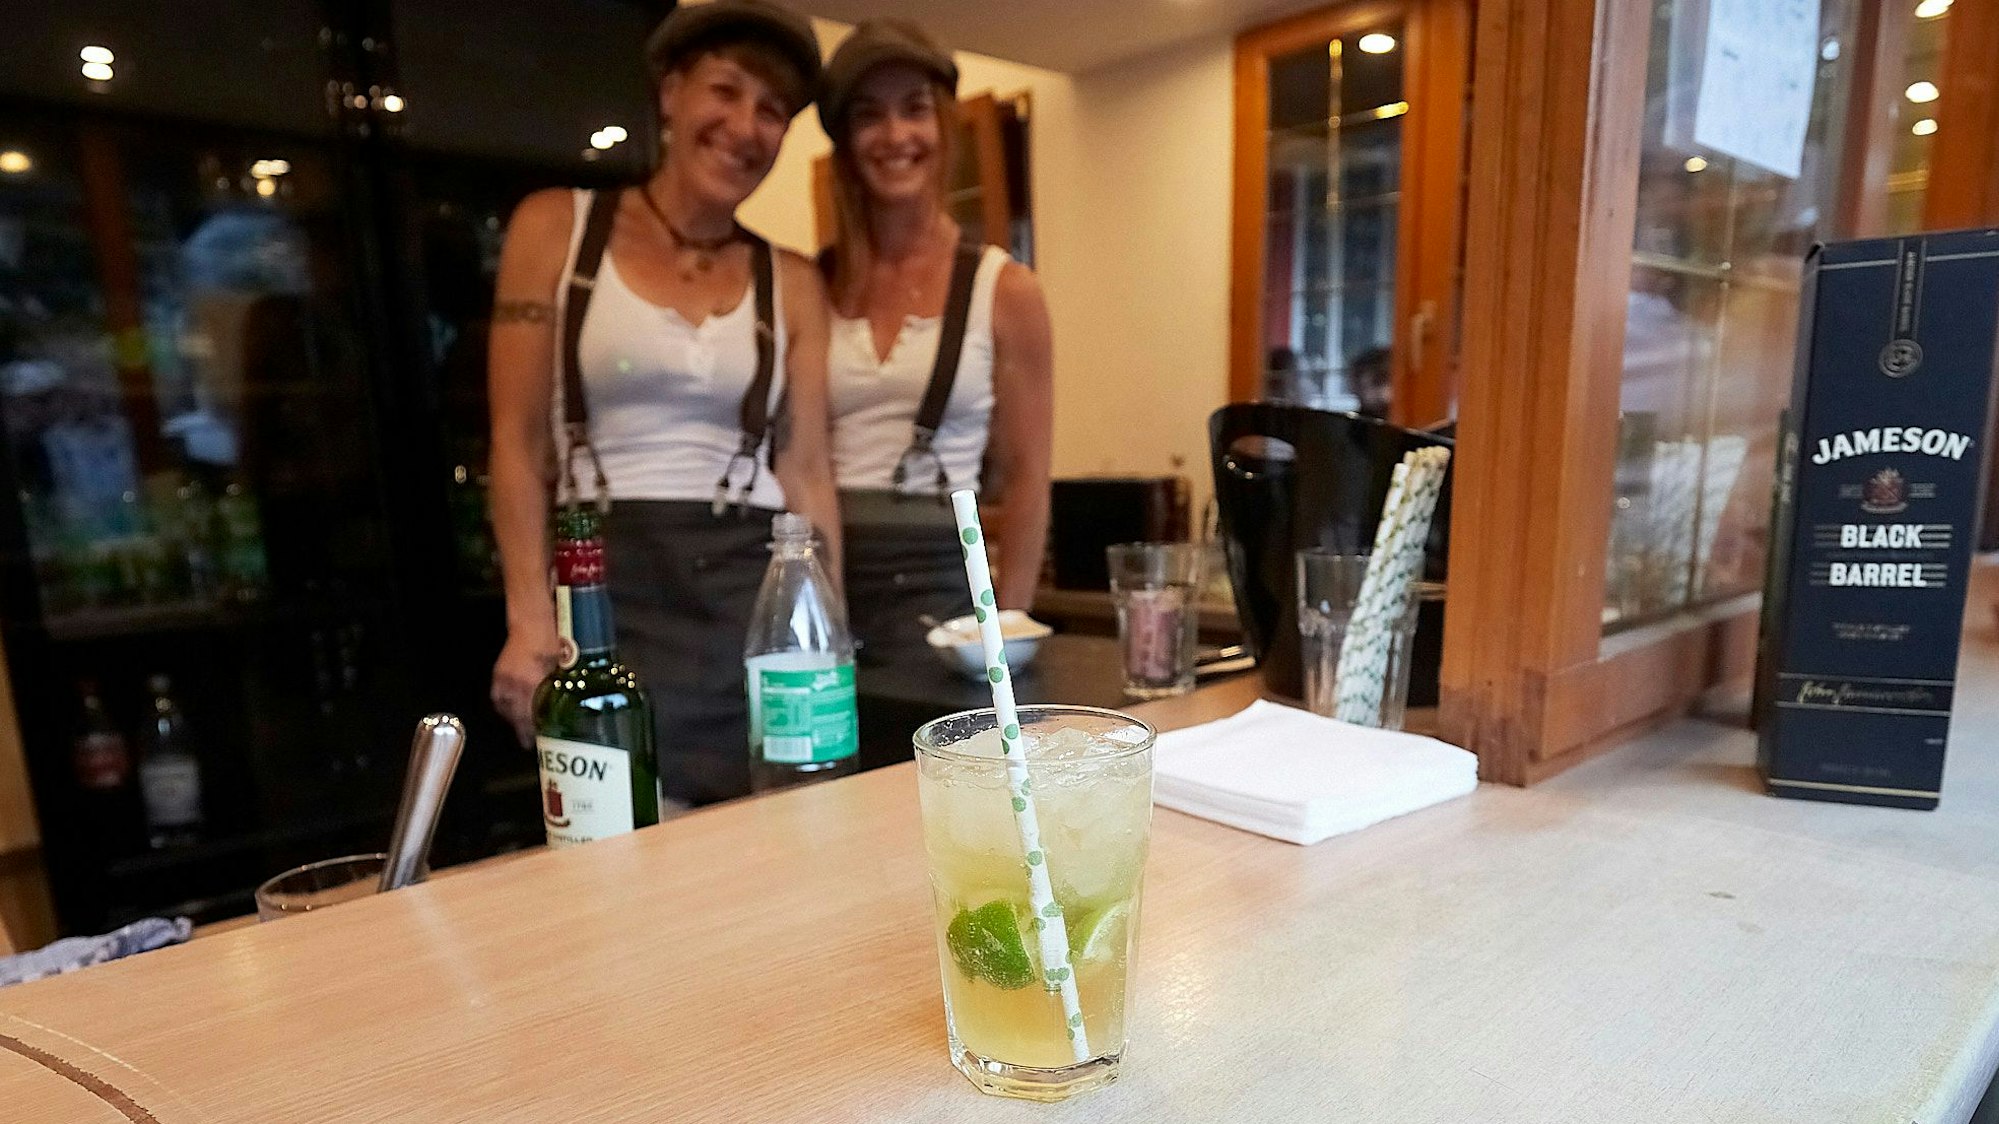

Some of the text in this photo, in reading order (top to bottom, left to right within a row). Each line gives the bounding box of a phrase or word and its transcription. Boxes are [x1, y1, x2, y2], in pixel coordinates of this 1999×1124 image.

[1812, 427, 1969, 464] JAMESON
[1840, 524, 1924, 548] BLACK
[1829, 563, 1927, 587] BARREL
